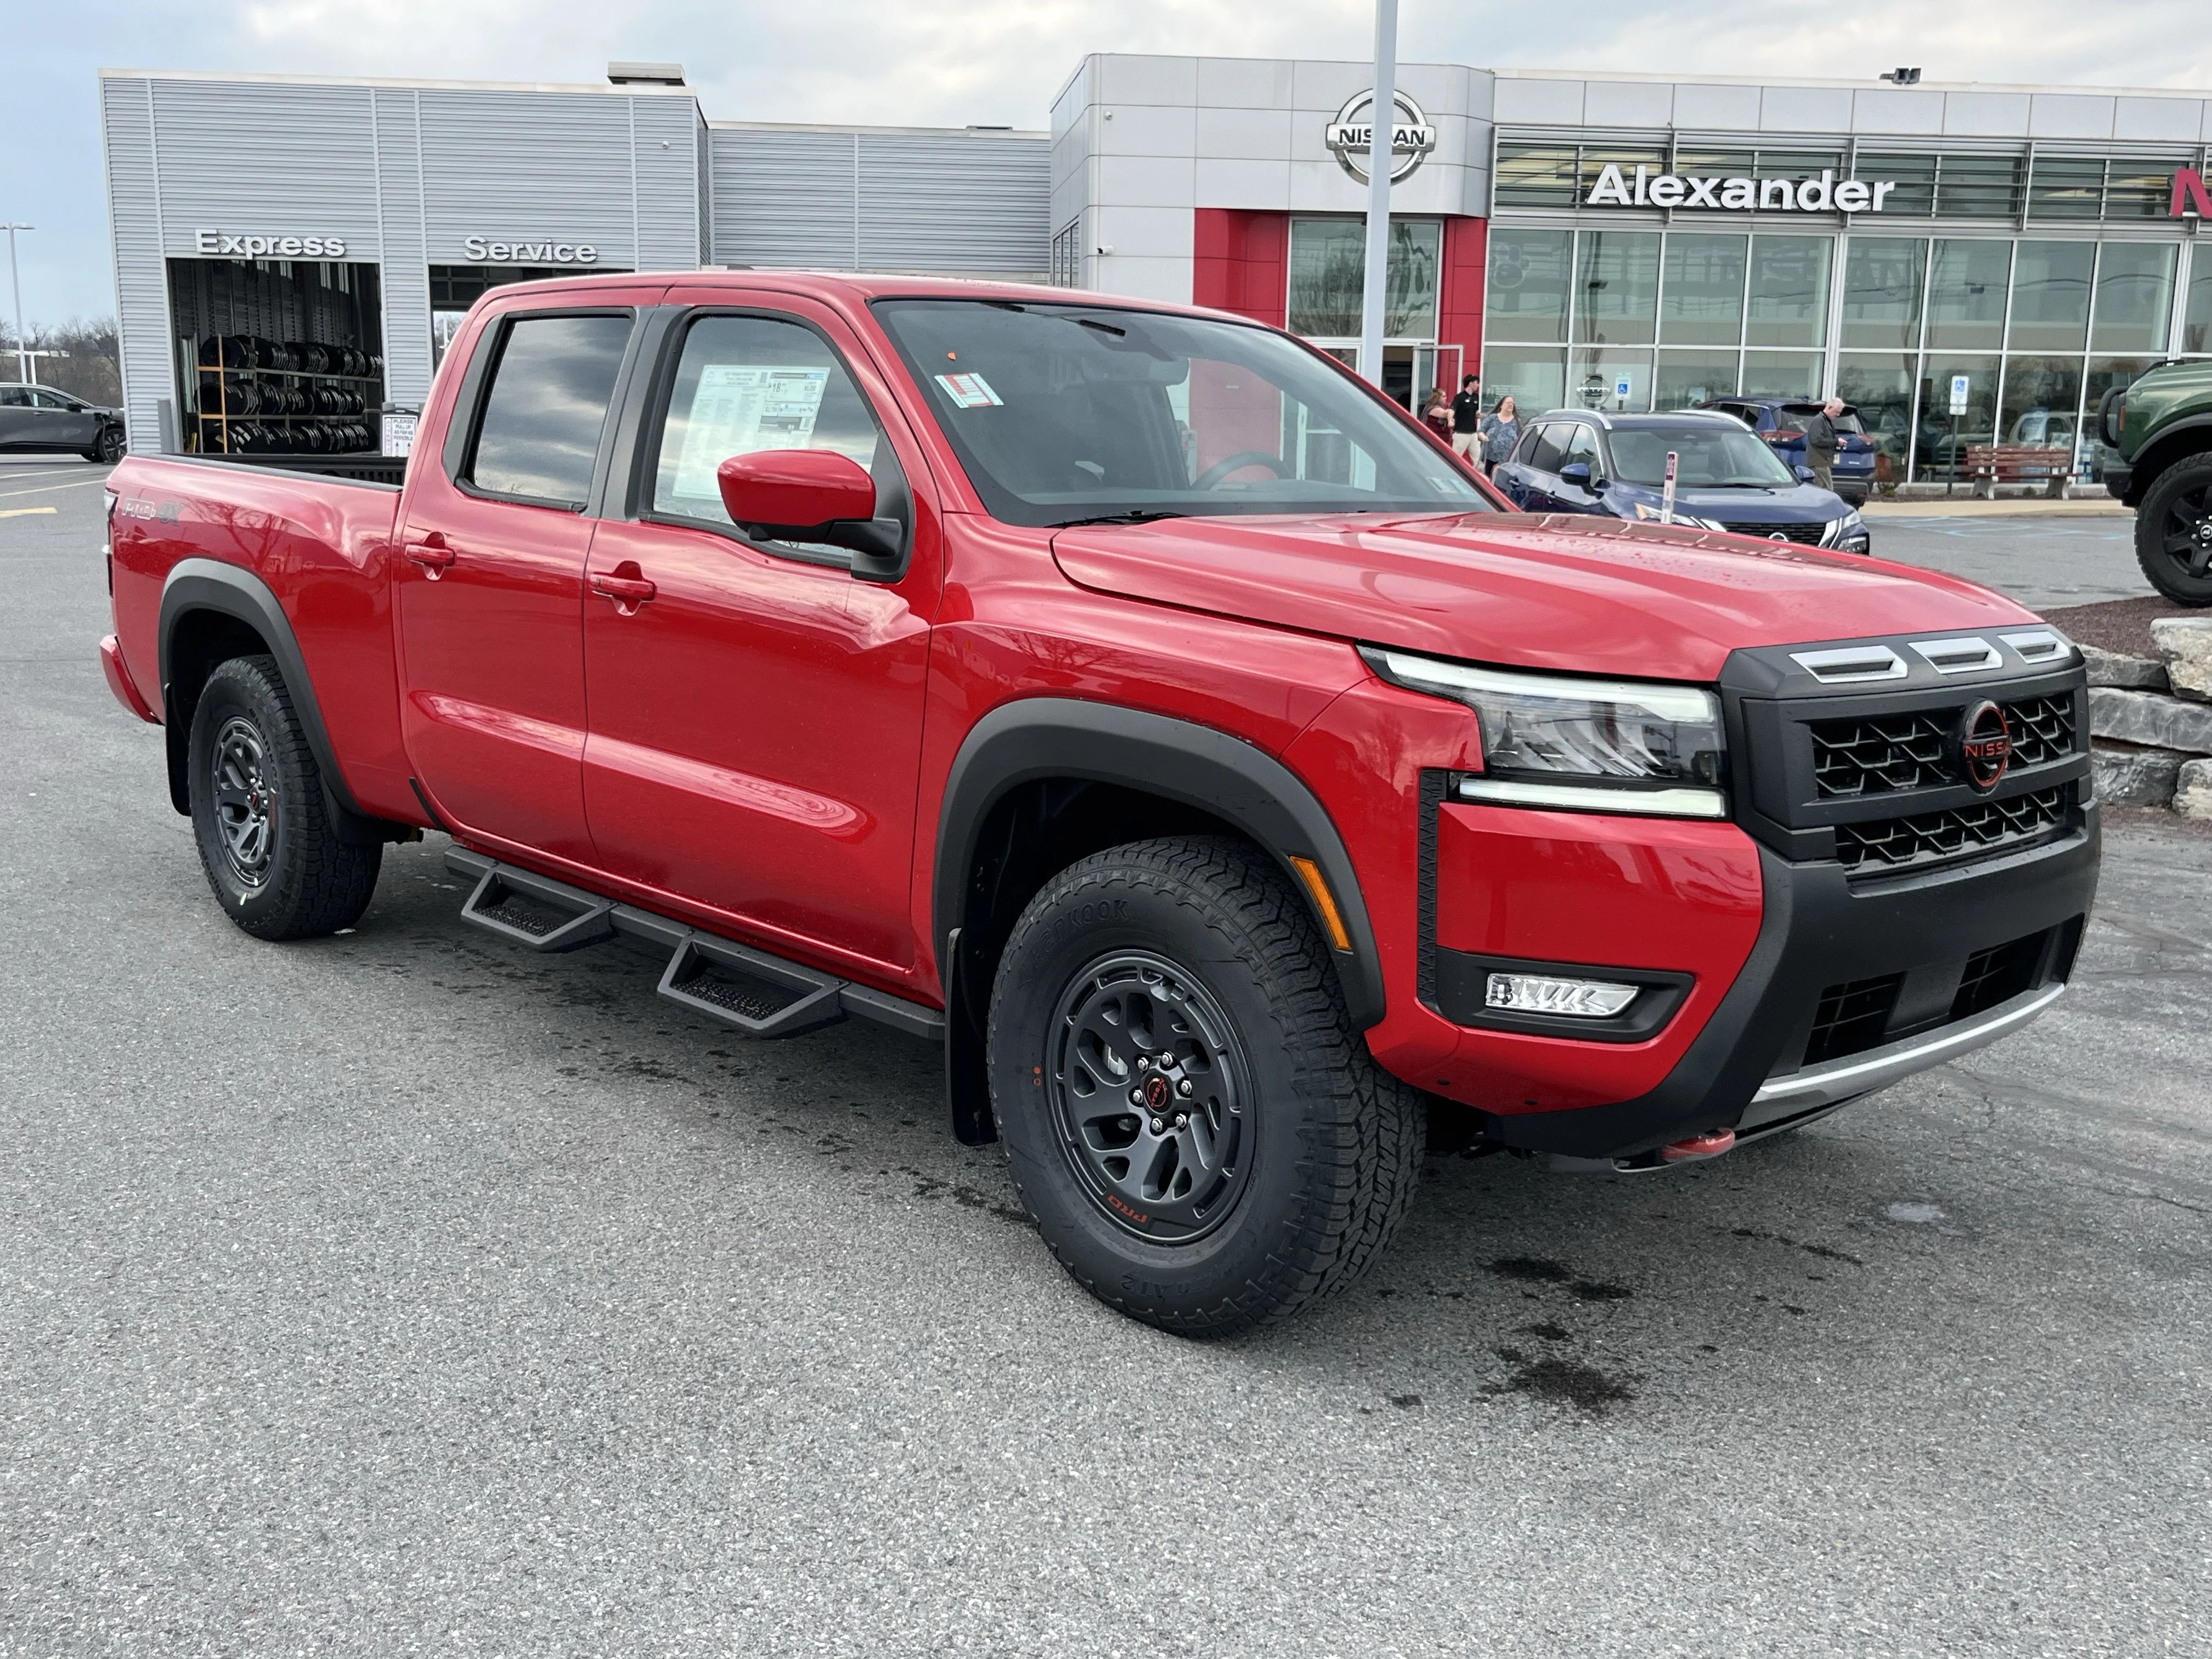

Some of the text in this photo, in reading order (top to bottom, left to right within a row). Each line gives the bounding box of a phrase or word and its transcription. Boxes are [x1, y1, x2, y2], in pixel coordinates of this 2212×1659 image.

[1339, 128, 1425, 145] NISAN
[1585, 164, 1895, 212] Alexander
[195, 228, 345, 259] Express
[464, 235, 597, 262] Service
[1108, 1195, 1148, 1223] PRO
